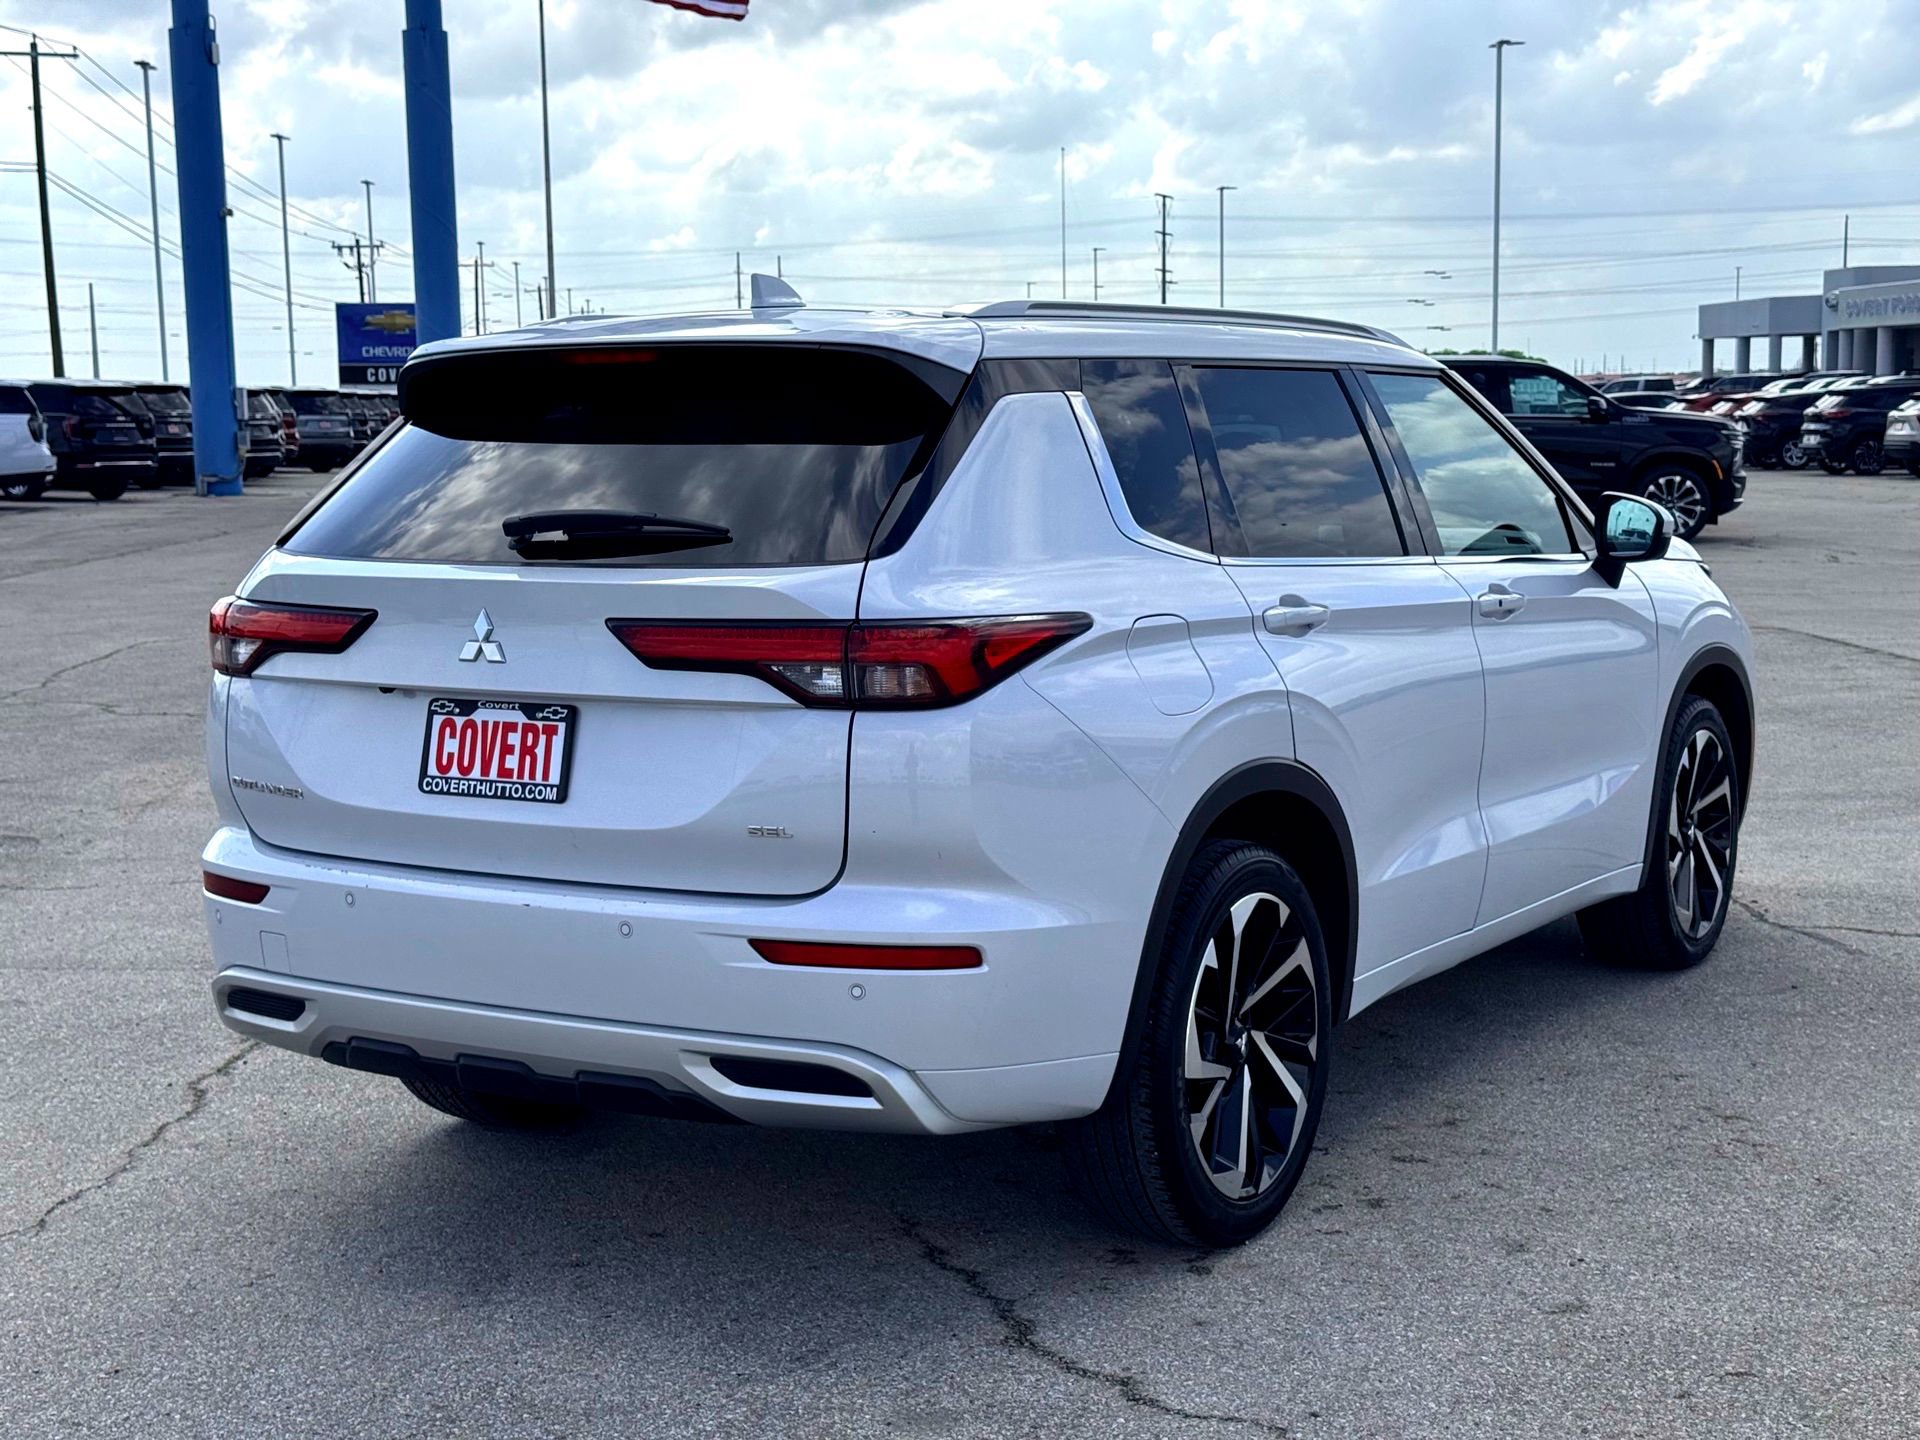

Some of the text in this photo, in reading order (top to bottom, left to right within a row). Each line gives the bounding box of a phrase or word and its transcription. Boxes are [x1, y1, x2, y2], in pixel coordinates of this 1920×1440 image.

[361, 345, 415, 358] CHEVRO
[477, 700, 520, 711] Covert
[435, 716, 559, 783] COVERT
[422, 777, 558, 801] COVERTHUTTO.COM
[747, 824, 794, 839] SEL
